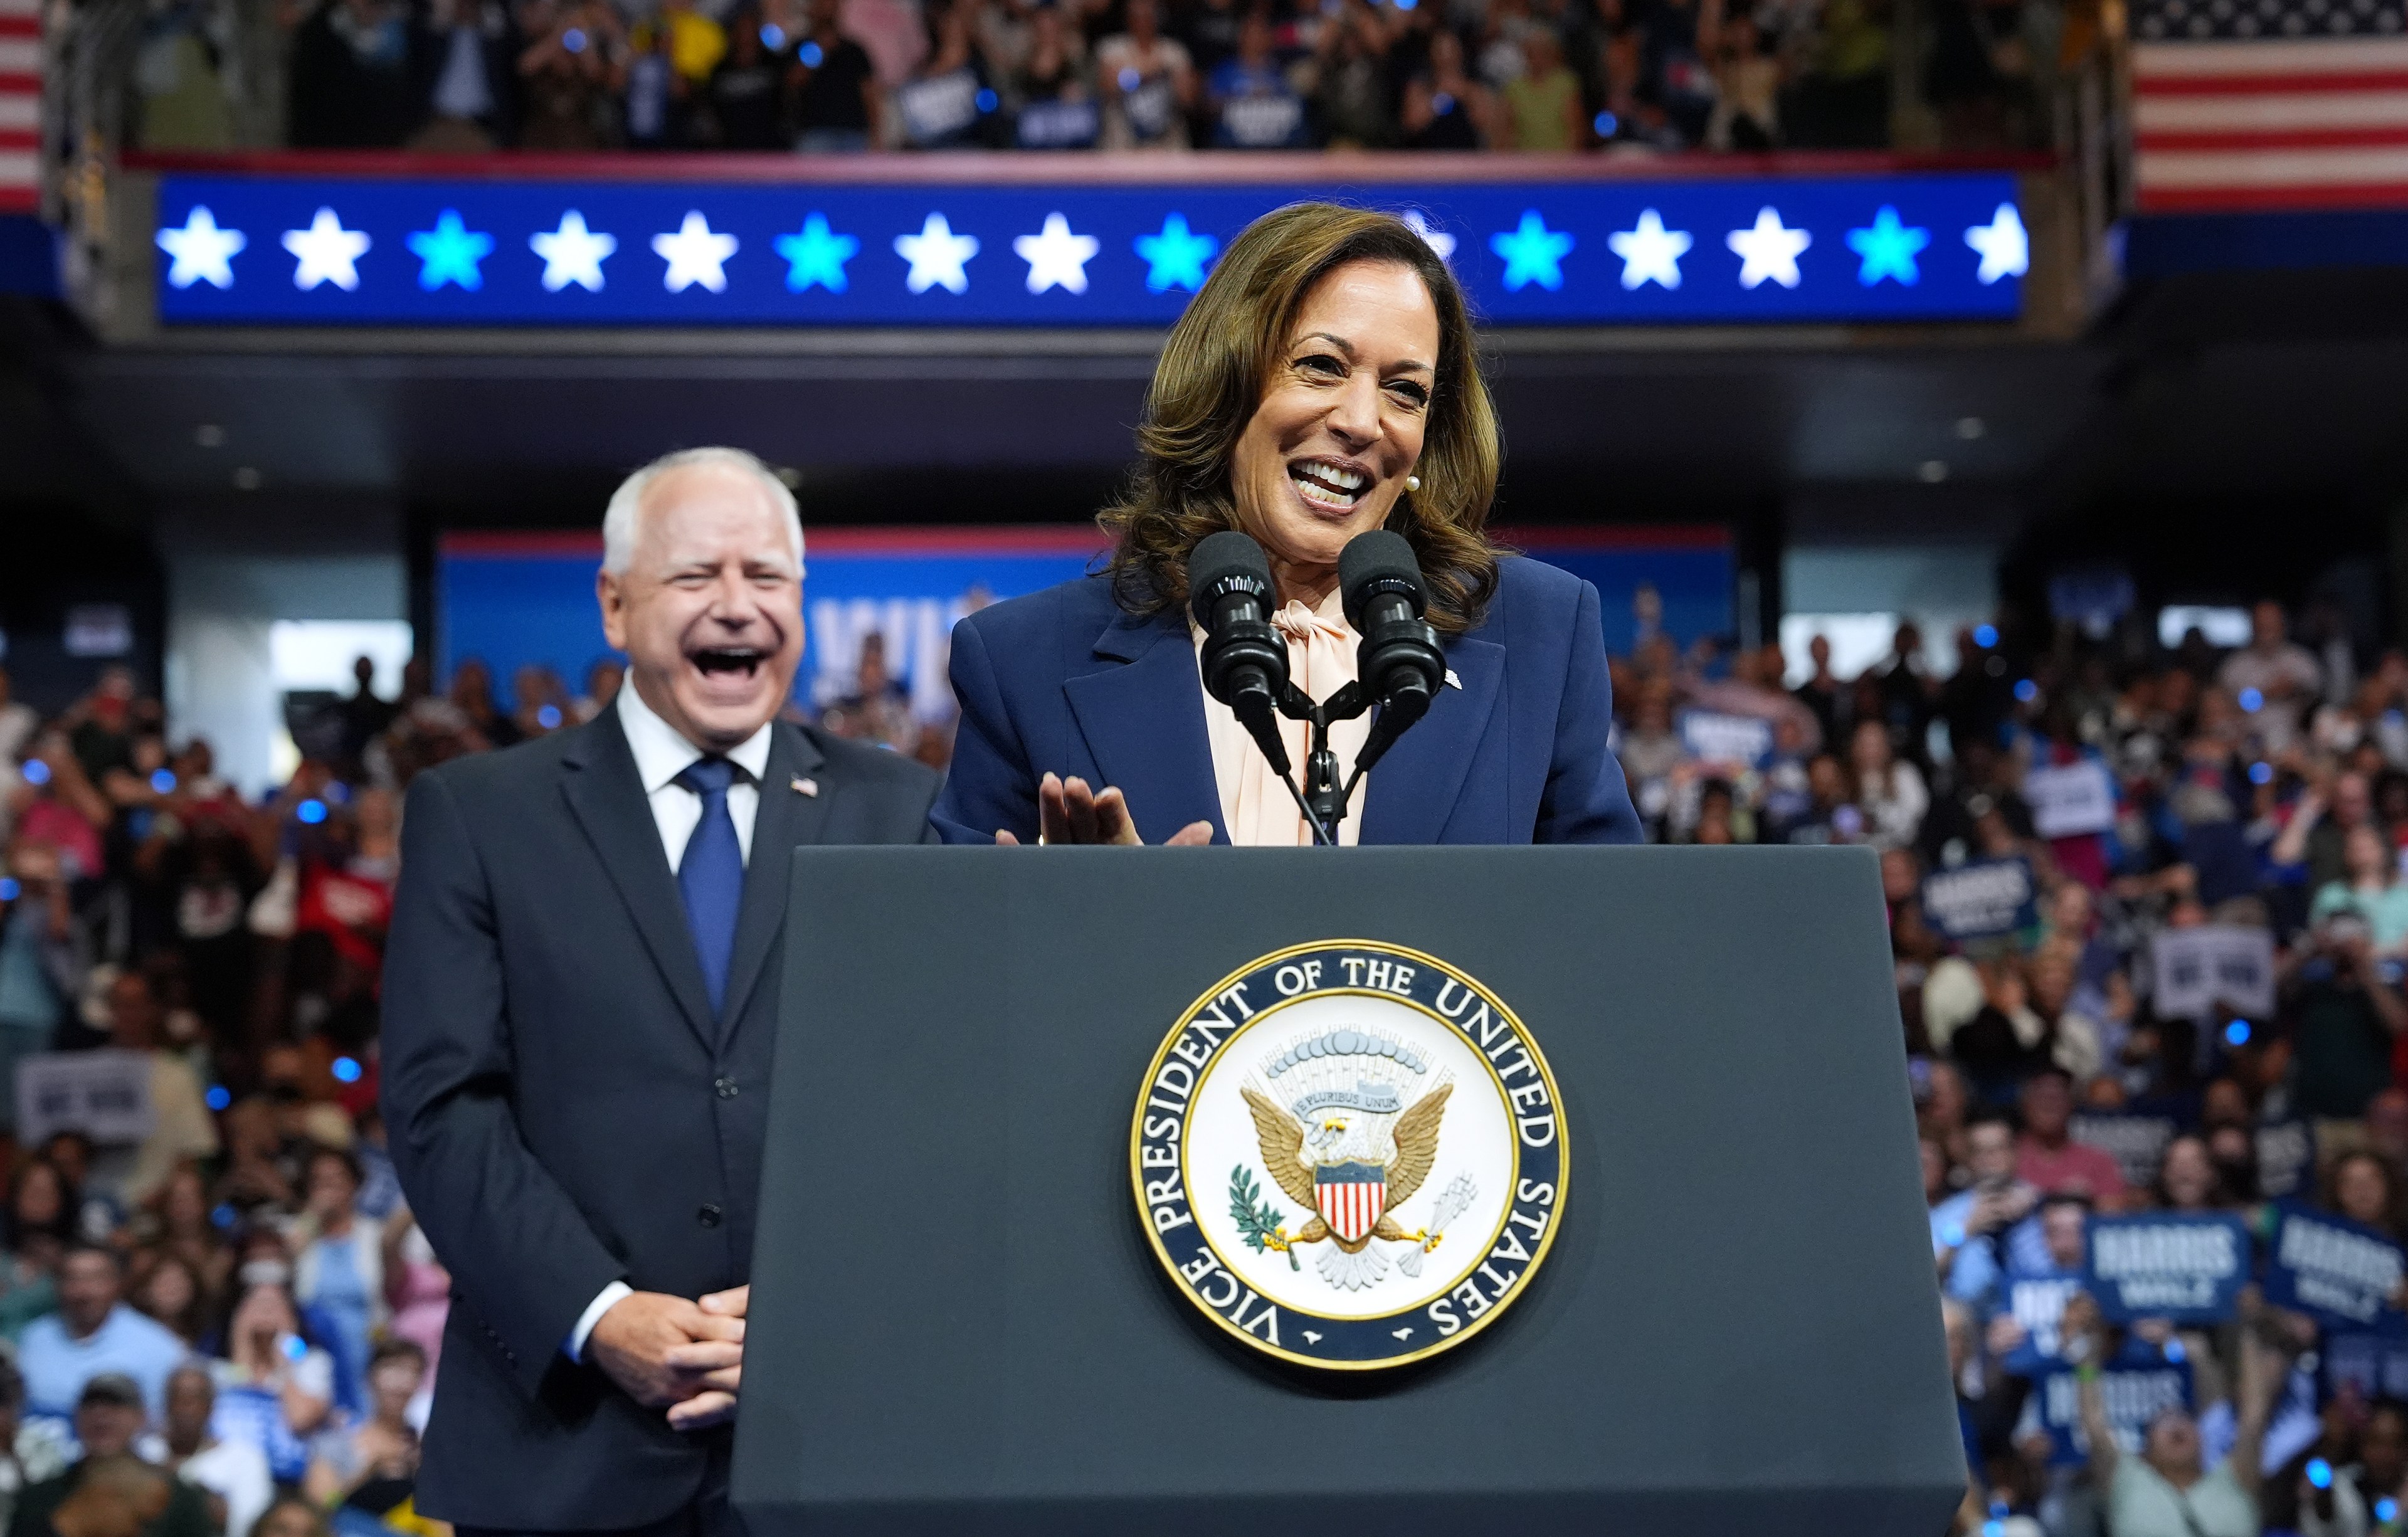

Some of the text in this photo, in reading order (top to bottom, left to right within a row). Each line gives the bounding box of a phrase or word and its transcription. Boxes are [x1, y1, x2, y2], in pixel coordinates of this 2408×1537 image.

[1142, 957, 1555, 1346] VICE PRESIDENT OF THE UNITED STATES
[1305, 1092, 1360, 1106] PLURIBUS
[1365, 1096, 1399, 1108] UNUM
